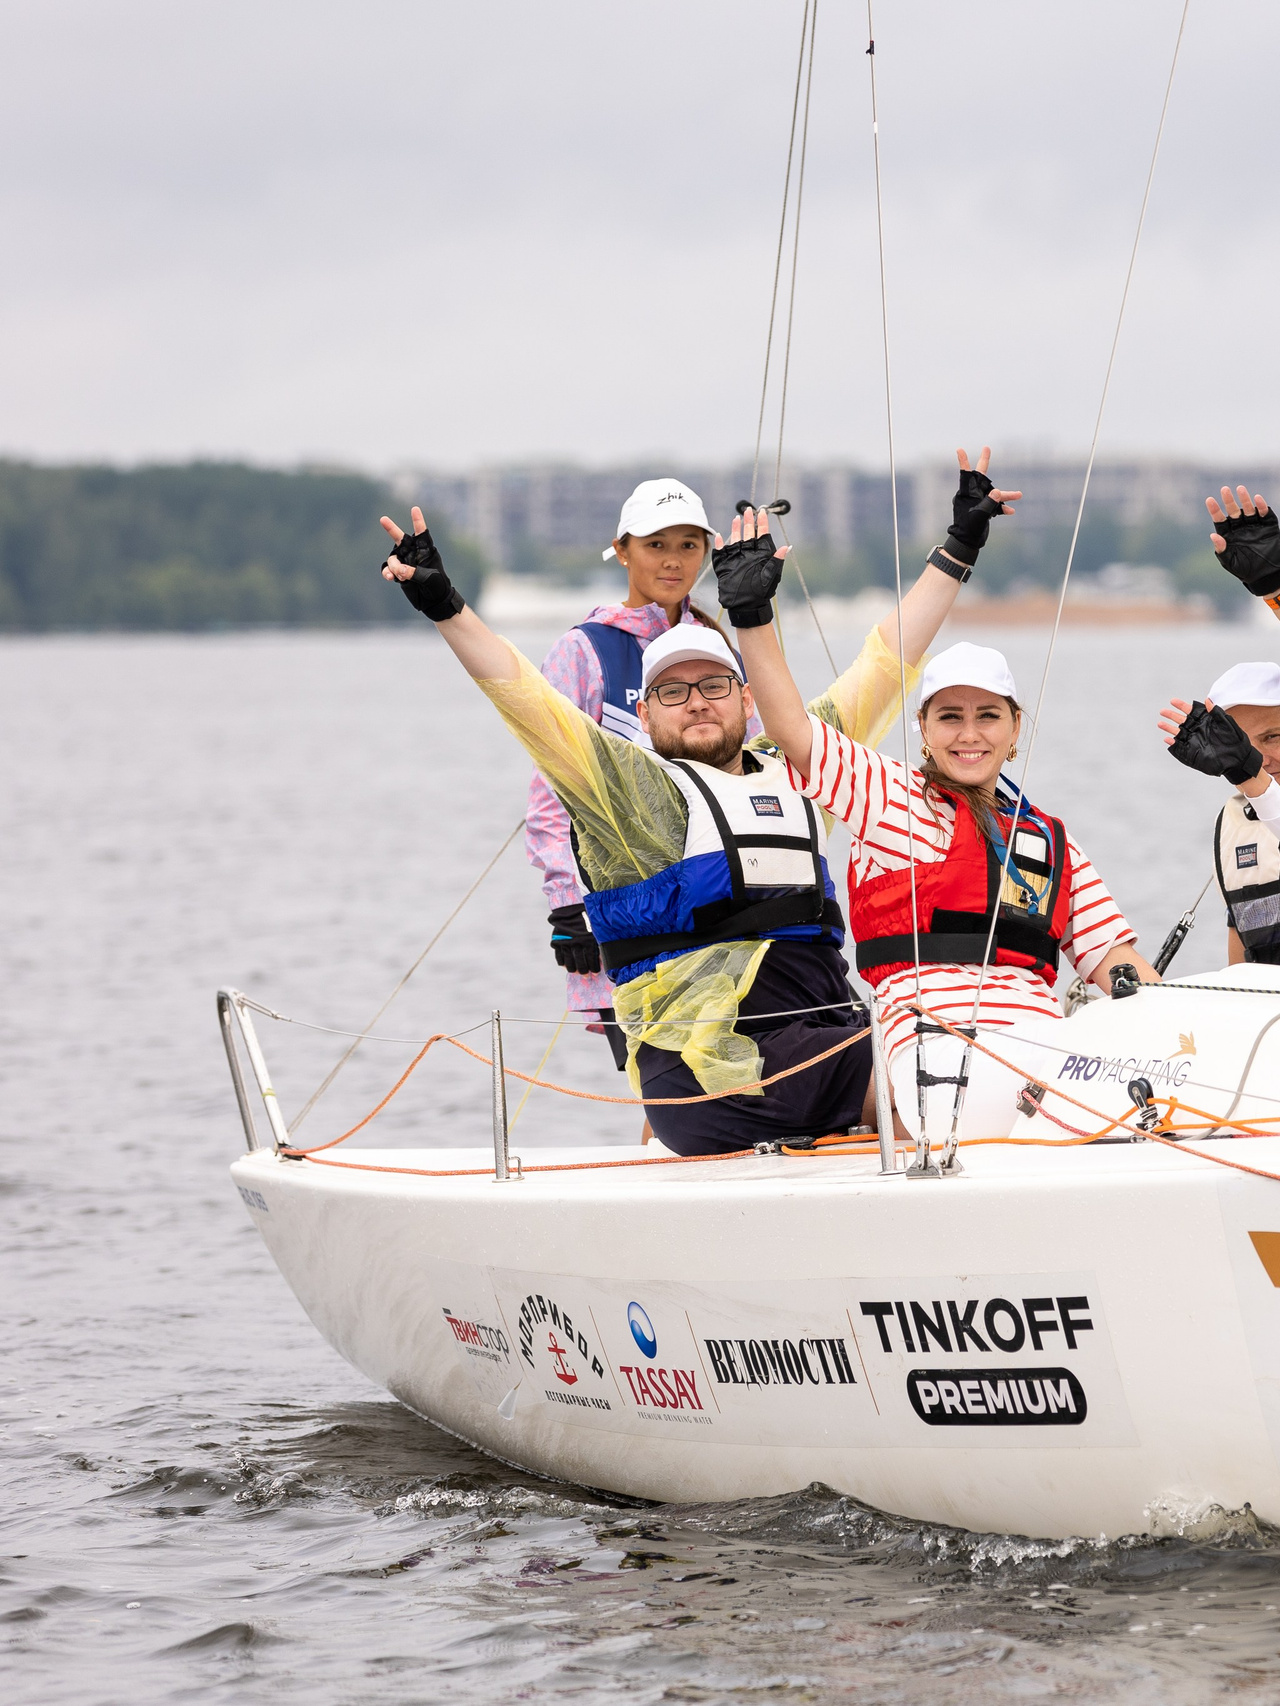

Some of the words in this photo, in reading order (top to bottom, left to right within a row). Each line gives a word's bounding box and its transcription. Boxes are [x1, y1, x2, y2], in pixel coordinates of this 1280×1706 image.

[1057, 1056, 1191, 1087] PROYACHTING
[519, 1294, 604, 1379] МОРПРИБОР
[860, 1296, 1094, 1355] TINKOFF
[704, 1339, 857, 1390] ВЕДОМОСТИ
[620, 1366, 704, 1410] TASSAY
[915, 1378, 1077, 1415] PREMIUM
[637, 1411, 663, 1421] PREMIUM
[663, 1413, 693, 1423] DRINKING
[693, 1416, 713, 1424] WATER
